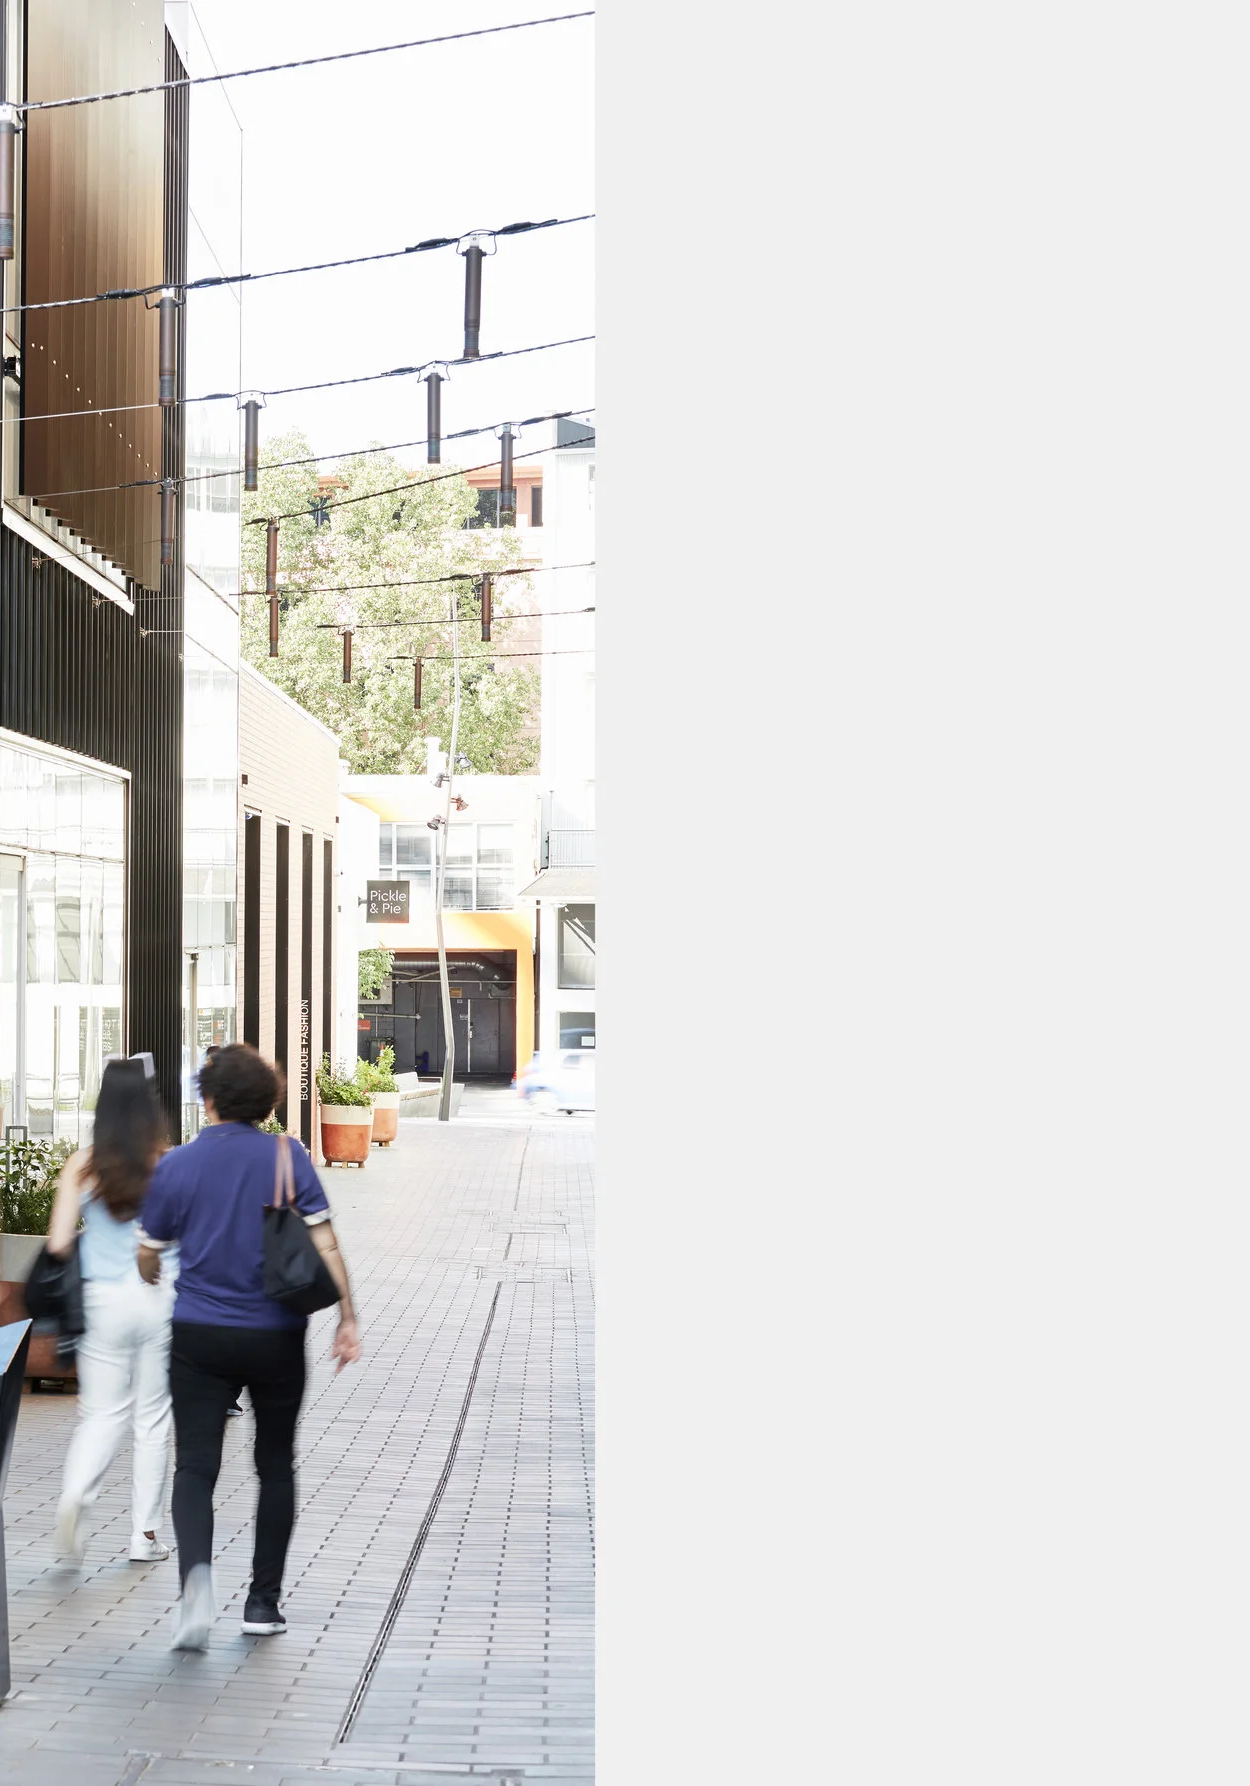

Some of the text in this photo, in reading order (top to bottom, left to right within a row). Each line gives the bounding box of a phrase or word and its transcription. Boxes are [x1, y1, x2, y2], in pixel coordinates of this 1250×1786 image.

[370, 889, 407, 902] Pickle
[369, 902, 402, 914] & Pie
[300, 999, 309, 1101] BOUTIQUE FASHION
